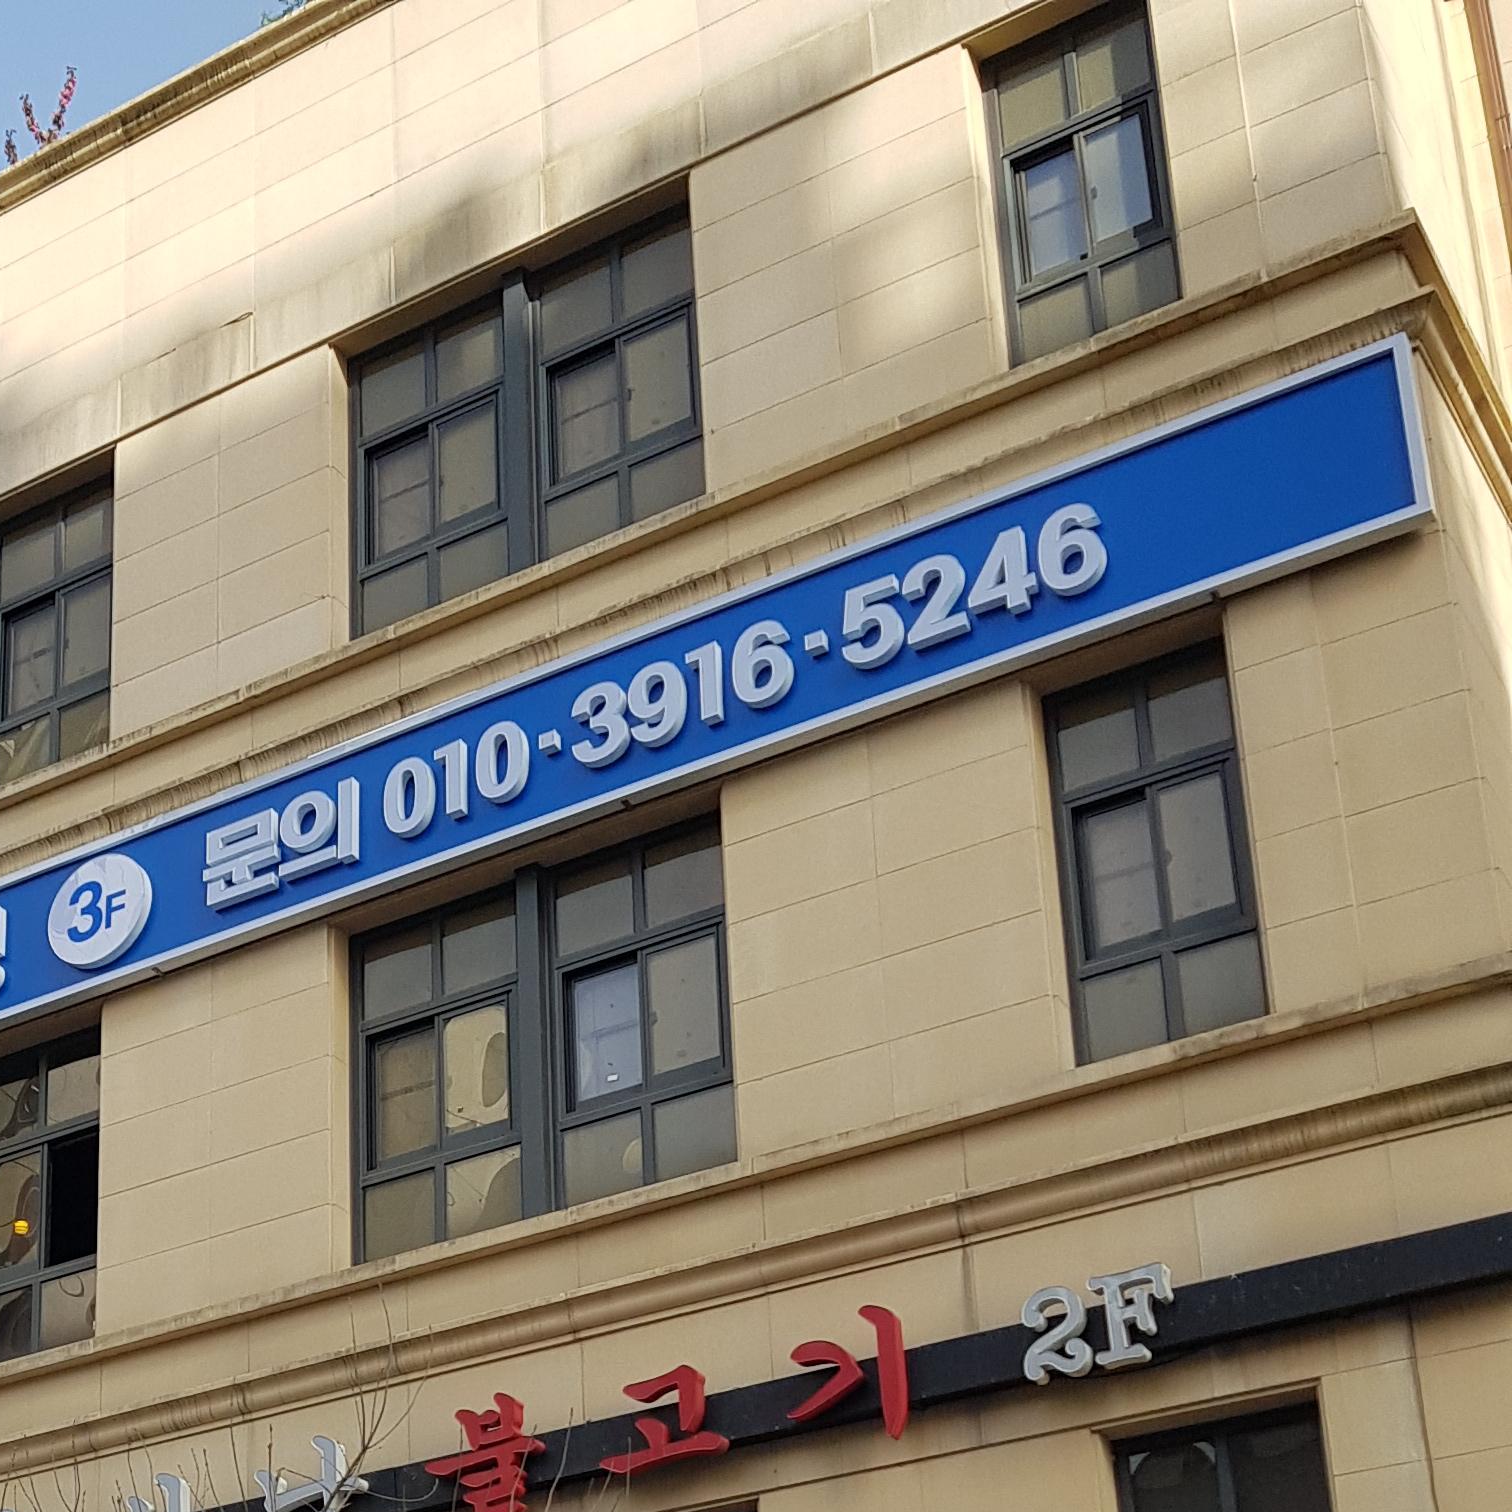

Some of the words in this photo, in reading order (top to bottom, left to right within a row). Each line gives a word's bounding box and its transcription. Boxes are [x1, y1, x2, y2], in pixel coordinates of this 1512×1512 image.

[68, 880, 127, 944] 3F
[202, 779, 361, 911] 문의
[1022, 1262, 1174, 1386] 2F
